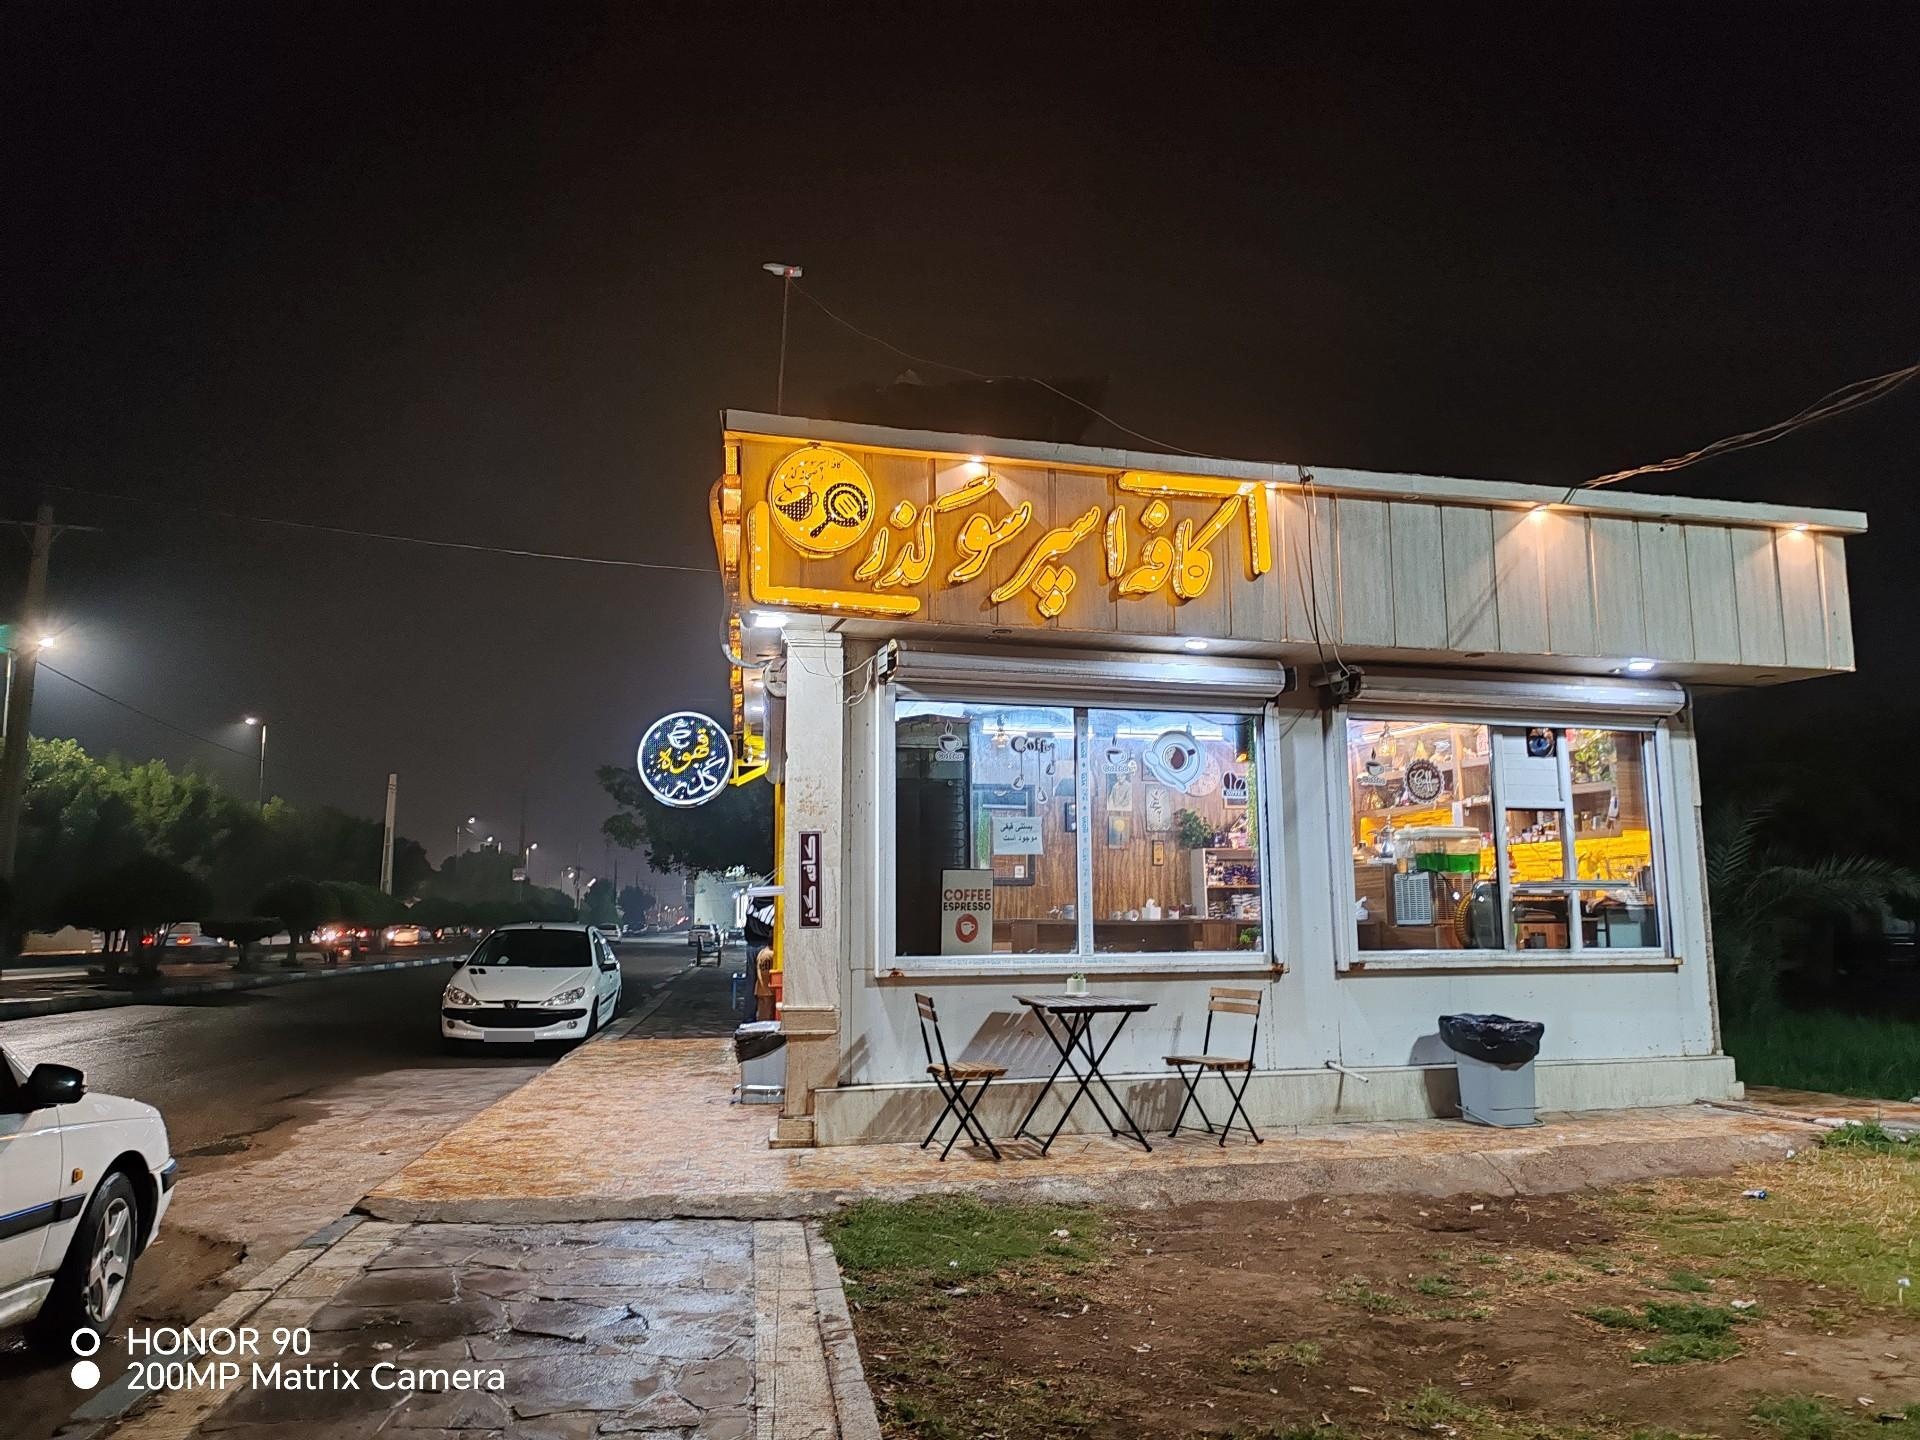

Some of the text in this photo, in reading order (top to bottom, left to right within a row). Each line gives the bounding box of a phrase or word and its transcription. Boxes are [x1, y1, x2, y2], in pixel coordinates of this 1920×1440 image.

[854, 475, 998, 592] گذر
[1118, 494, 1243, 598] کافه
[657, 727, 710, 775] قهوه
[801, 835, 817, 882] کافه
[943, 888, 992, 902] COFFEE
[943, 901, 992, 911] ESPRESSO
